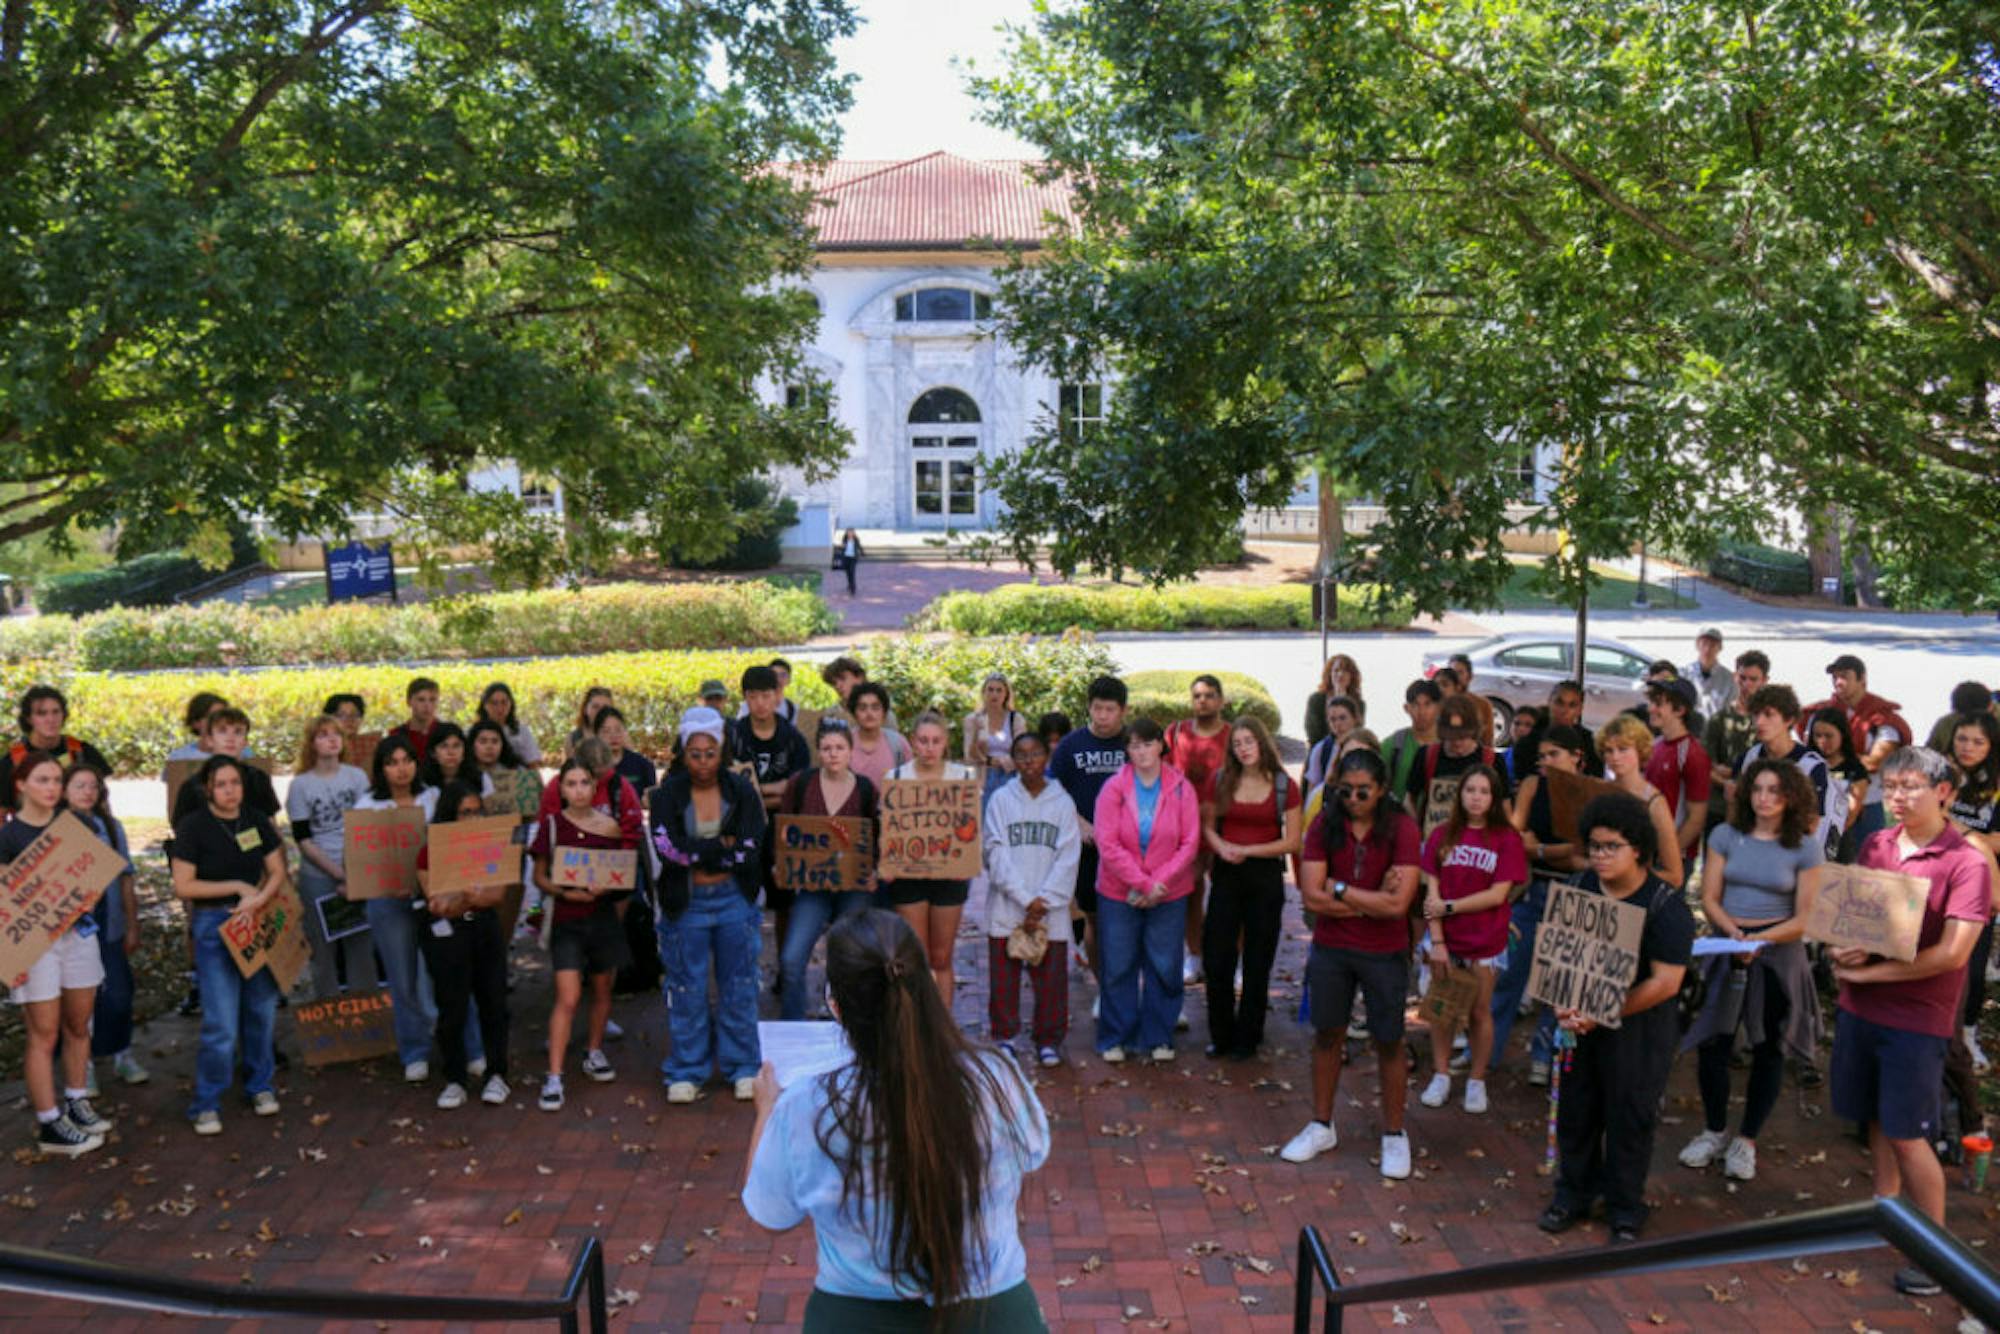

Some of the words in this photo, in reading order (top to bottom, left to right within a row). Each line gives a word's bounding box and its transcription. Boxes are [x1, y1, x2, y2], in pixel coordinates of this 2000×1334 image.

[1074, 750, 1125, 769] EMOR
[884, 784, 975, 810] CLIMATE
[887, 809, 961, 832] ACTION
[5, 901, 48, 945] 2050
[41, 886, 85, 934] LATE
[1549, 889, 1619, 942] ACTIONS
[1540, 928, 1586, 969] SPEAK
[297, 1003, 334, 1023] HOT
